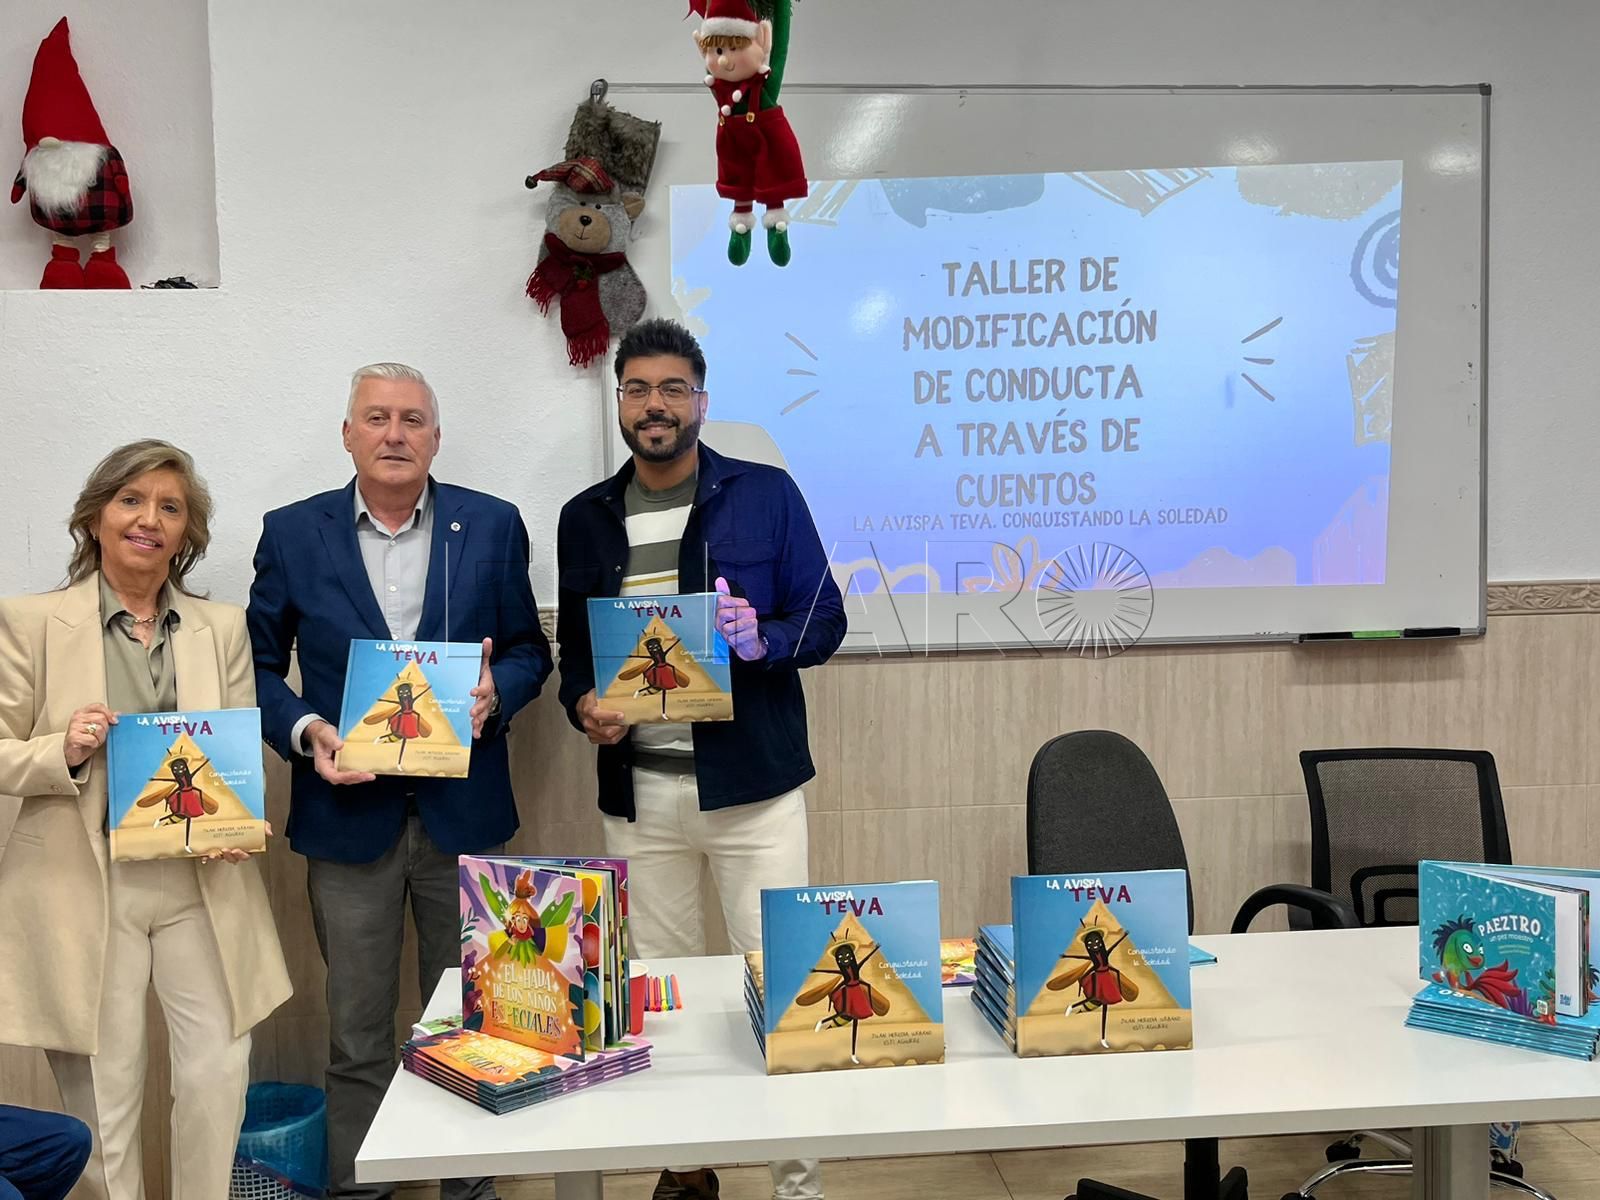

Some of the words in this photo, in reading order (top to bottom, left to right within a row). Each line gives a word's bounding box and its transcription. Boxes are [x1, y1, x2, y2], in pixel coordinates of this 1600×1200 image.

[942, 259, 1066, 297] TALLER
[1080, 257, 1119, 292] DE
[902, 298, 1158, 351] MODIFICACIÓN
[914, 370, 952, 404] DE
[965, 364, 1144, 403] CONDUCTA
[914, 424, 943, 458] A
[957, 408, 1088, 456] TRAVÉS
[1101, 418, 1141, 452] DE
[956, 471, 1097, 507] CUENTOS
[853, 515, 874, 531] LA
[880, 515, 944, 531] AVISPA
[952, 514, 997, 530] TEVA.
[1002, 510, 1124, 529] CONQUISTANDO
[1129, 509, 1151, 526] LA
[1157, 507, 1229, 525] SOLEDAD
[614, 601, 625, 609] LA
[633, 605, 682, 619] TEVA
[375, 642, 386, 651] LA
[393, 650, 438, 665] TEVA
[137, 716, 150, 726] LA
[152, 714, 188, 725] AVISPA
[158, 720, 213, 737] TEVA
[1046, 879, 1060, 890] LA
[1063, 878, 1103, 890] AVISPA
[1069, 885, 1132, 904] TEVA
[797, 892, 810, 903] LA
[814, 890, 855, 903] AVISPA
[820, 897, 884, 917] TEVA
[1478, 914, 1541, 936] PAEZTRO
[504, 963, 518, 984] EL
[523, 968, 552, 993] HADA
[492, 982, 504, 999] DE
[506, 984, 523, 1005] LOS
[528, 990, 557, 1014] NIÑOS
[491, 1001, 561, 1038] ESPECIALES
